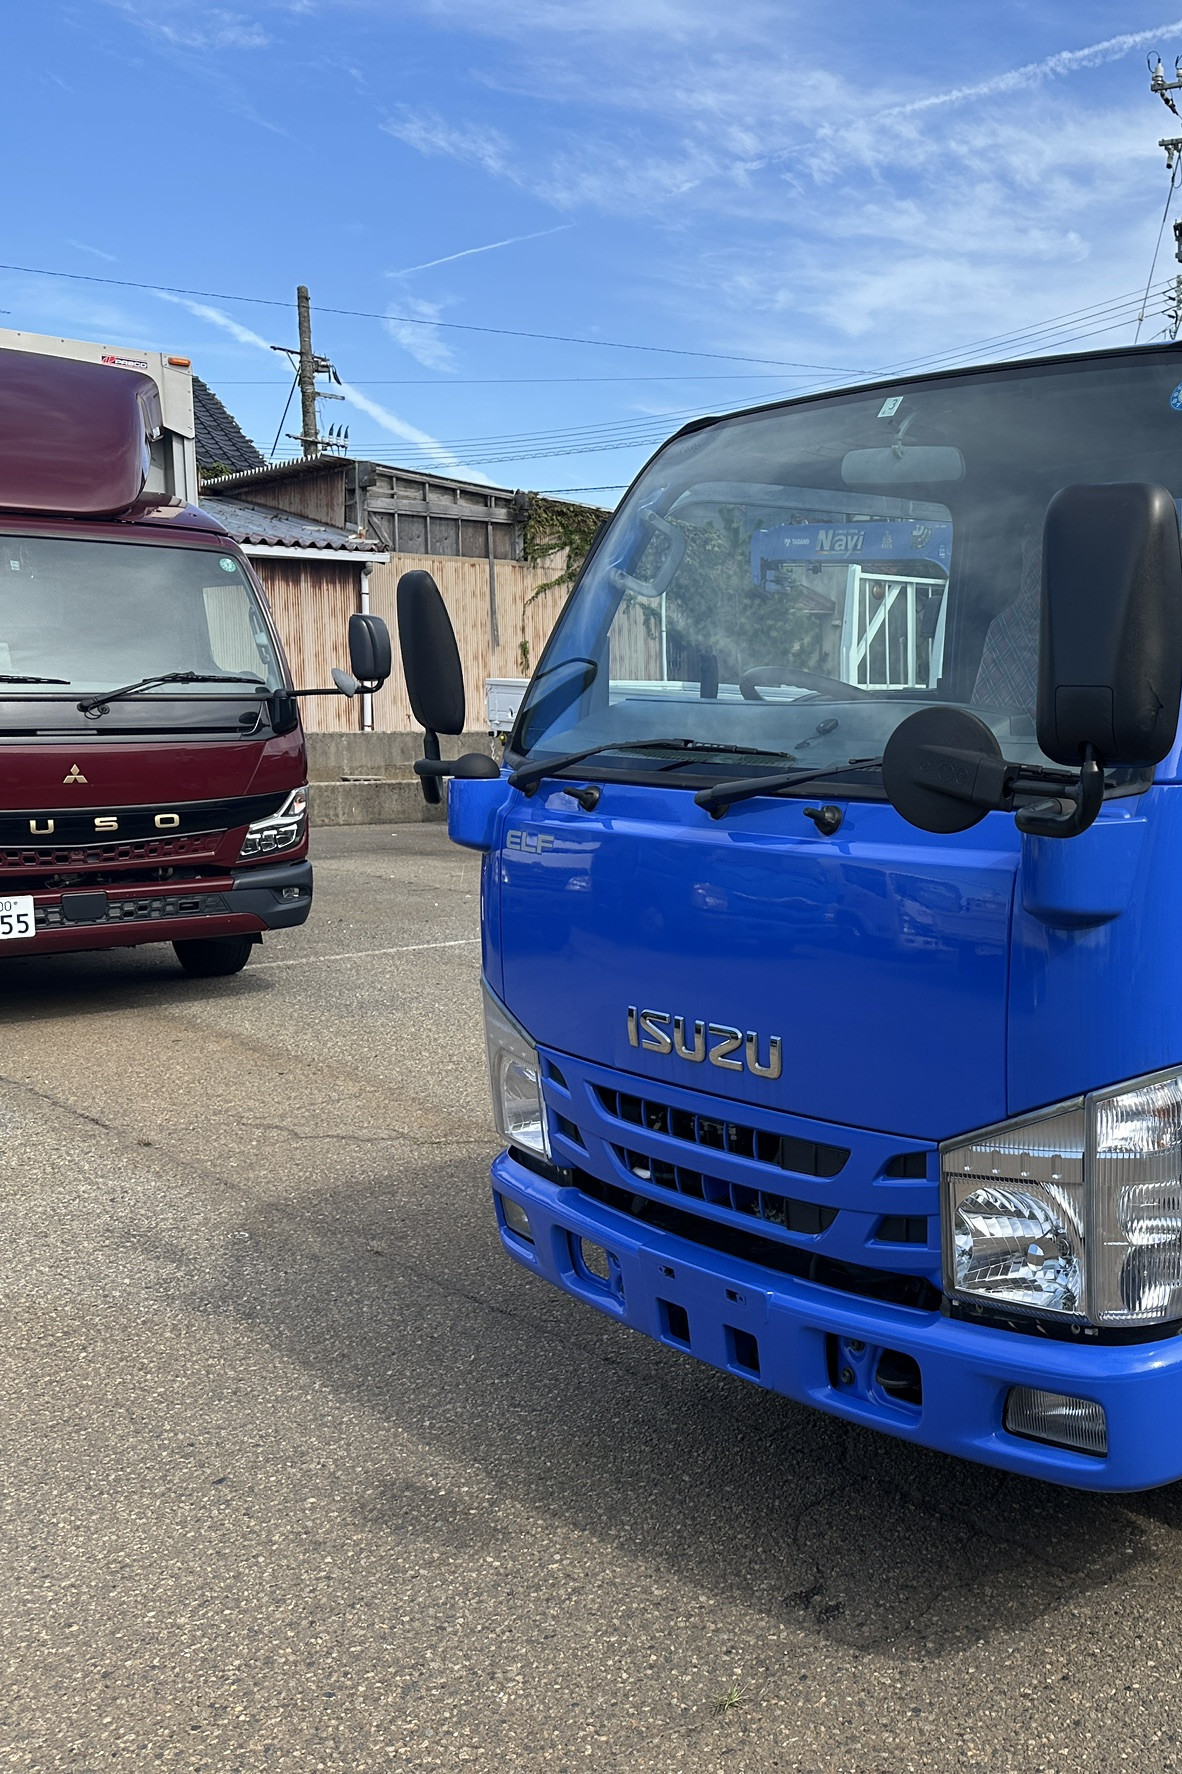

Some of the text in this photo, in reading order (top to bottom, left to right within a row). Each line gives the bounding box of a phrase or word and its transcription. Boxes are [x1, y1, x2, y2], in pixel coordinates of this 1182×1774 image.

[506, 829, 554, 855] ELF
[0, 913, 29, 935] 55
[627, 1005, 782, 1079] ISUZU
